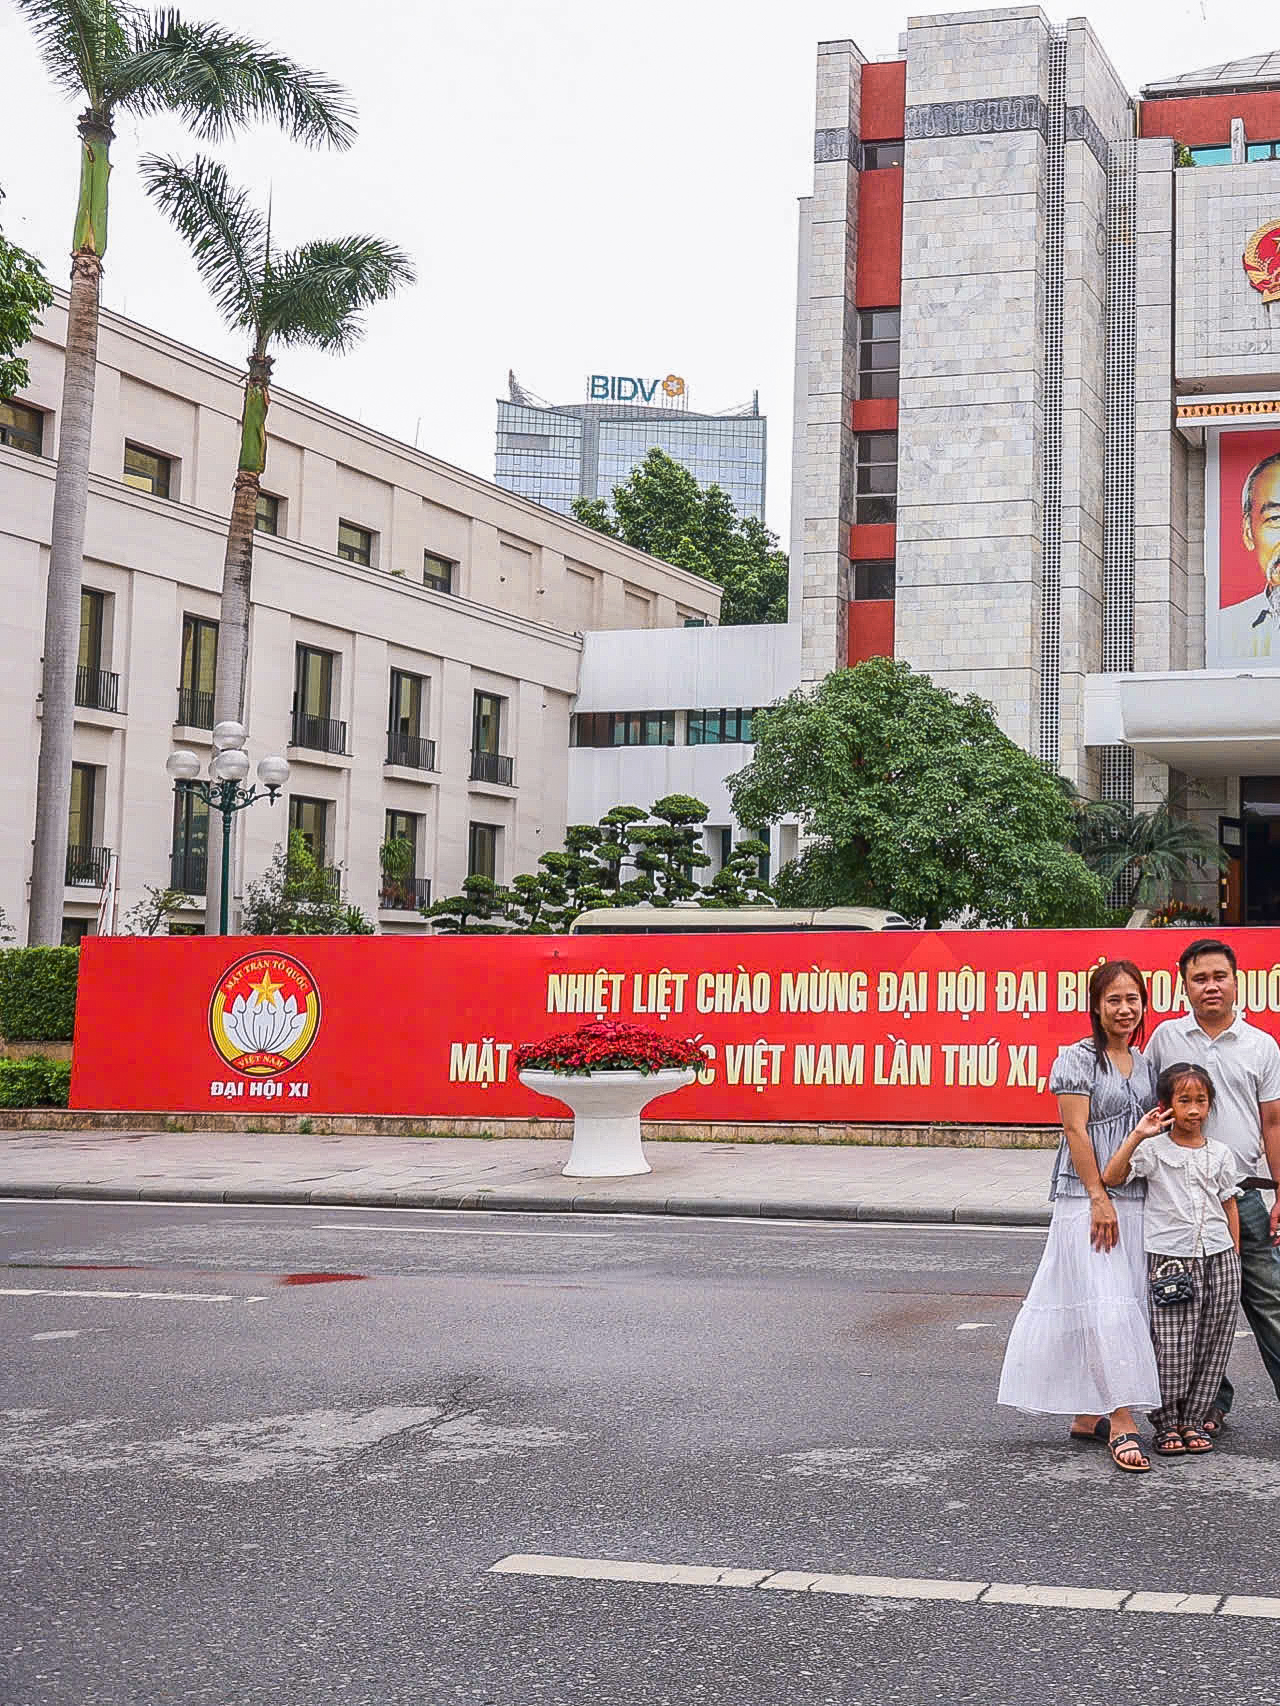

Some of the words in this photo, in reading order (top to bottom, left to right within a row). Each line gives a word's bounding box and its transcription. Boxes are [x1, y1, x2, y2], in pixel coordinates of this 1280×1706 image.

[590, 375, 661, 402] BIDV
[546, 967, 625, 1021] NHIỆT
[632, 967, 689, 1021] LIỆT
[696, 964, 770, 1014] CHÀO
[780, 964, 867, 1014] MỪNG
[877, 970, 928, 1019] ĐẠI
[937, 965, 985, 1021] HỘI
[995, 970, 1047, 1019] ĐẠI
[1141, 962, 1193, 1013] TOÀ
[449, 1037, 513, 1089] MẶT
[725, 1038, 785, 1092] VIỆT
[793, 1045, 864, 1085] NAM
[873, 1034, 934, 1085] LẦN
[941, 1038, 1000, 1086] THỨ
[1006, 1045, 1048, 1094] XI,
[210, 1081, 244, 1099] ĐẠI
[249, 1079, 283, 1100] HỘI
[288, 1082, 309, 1097] XI
